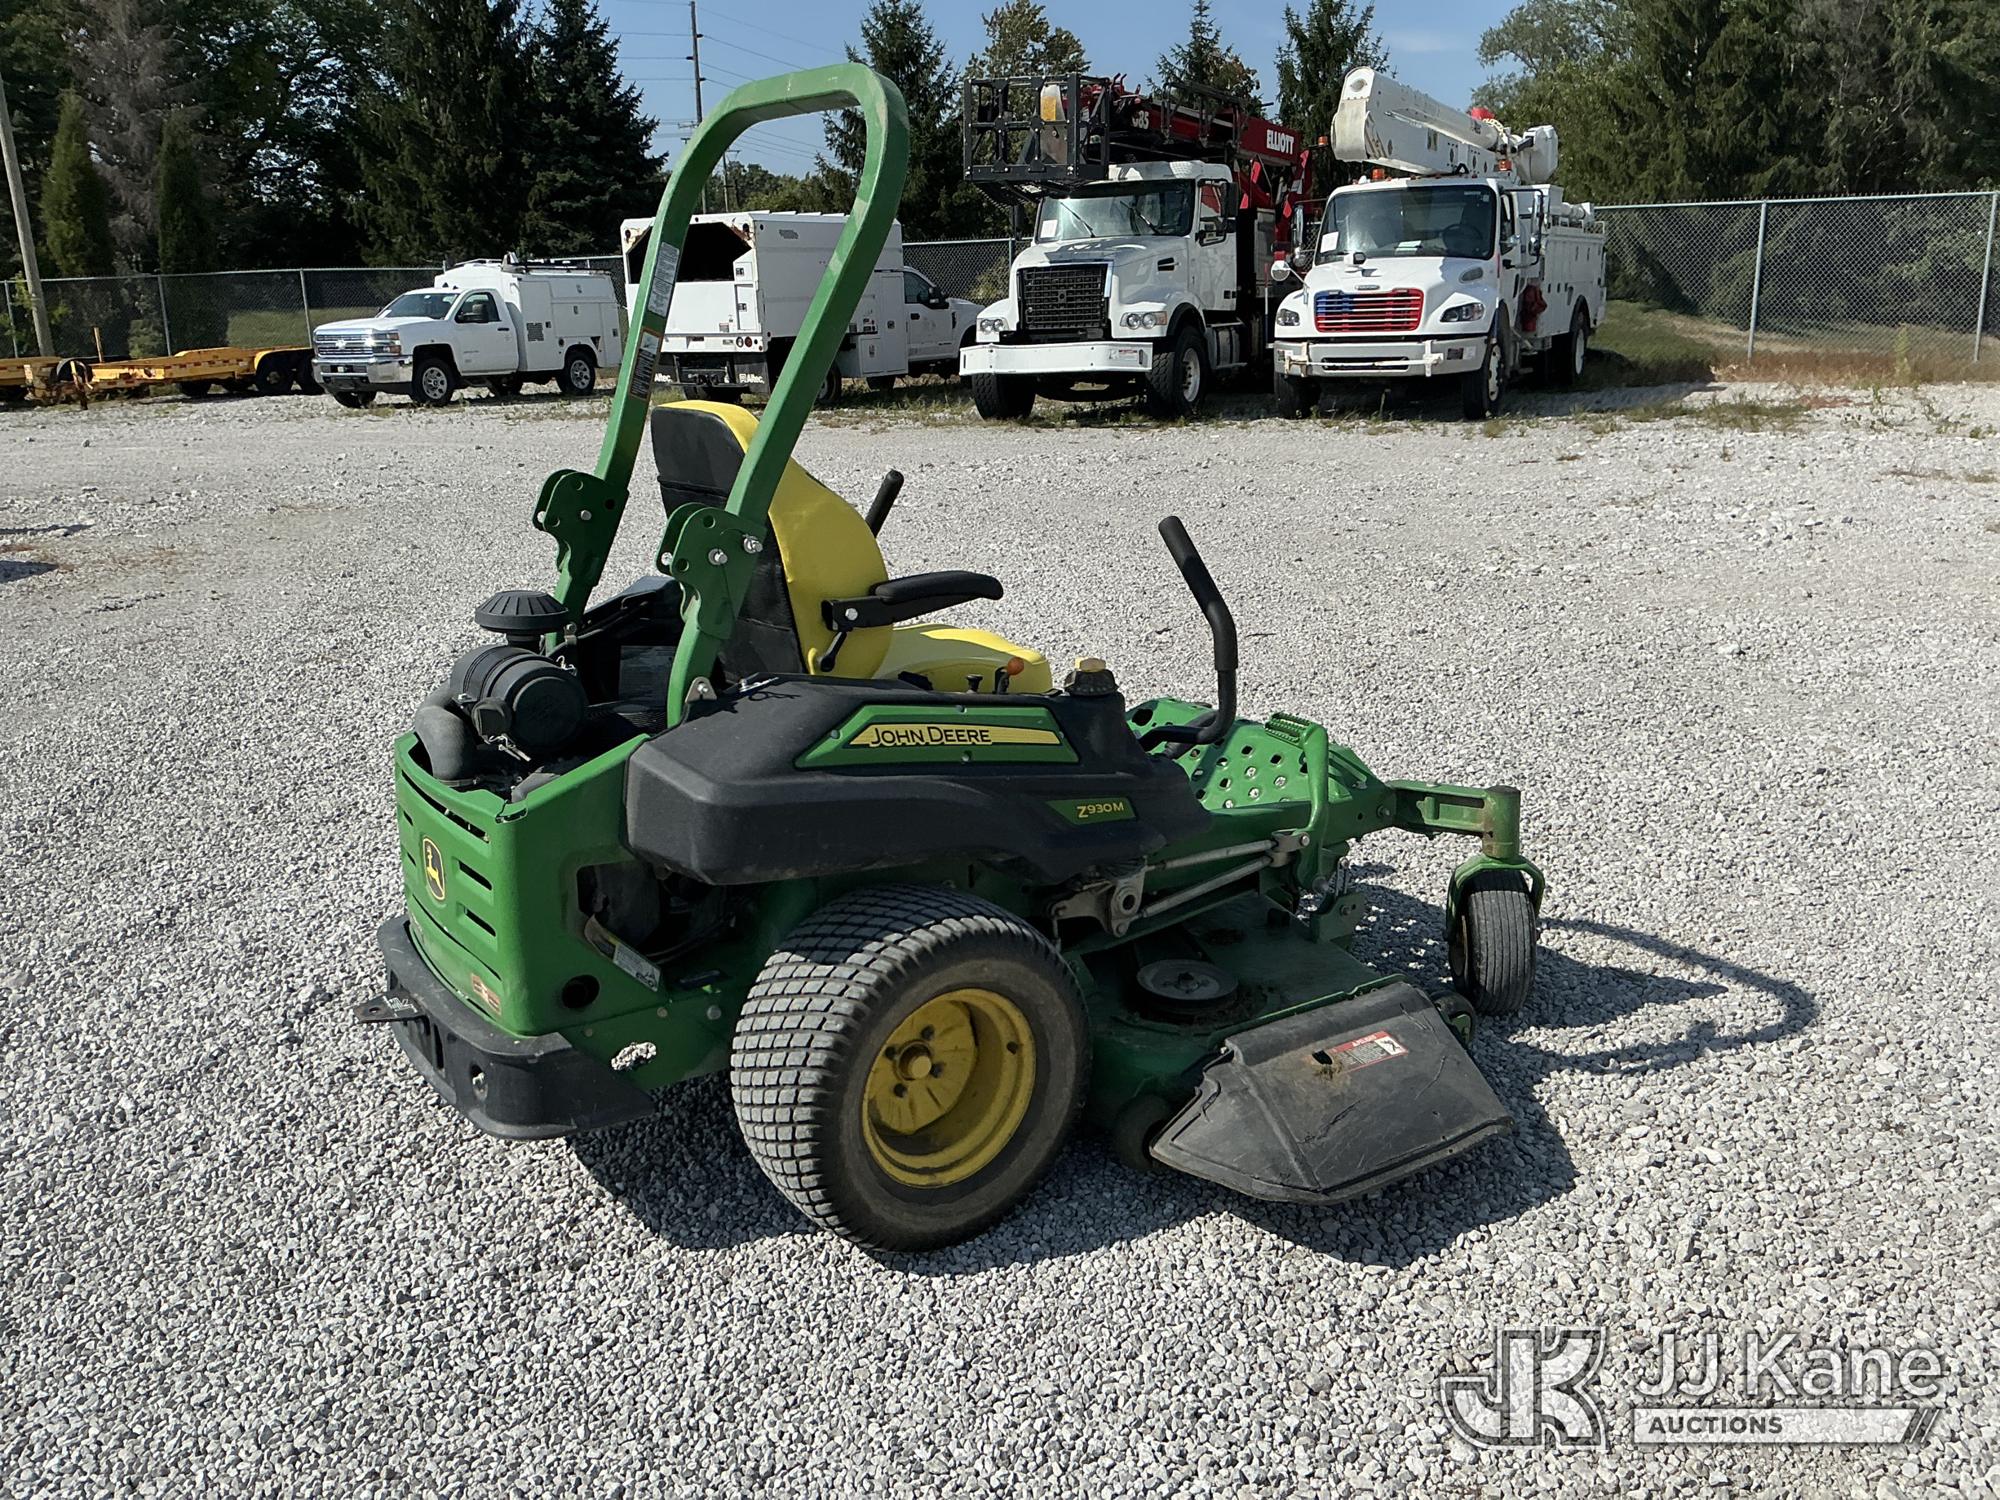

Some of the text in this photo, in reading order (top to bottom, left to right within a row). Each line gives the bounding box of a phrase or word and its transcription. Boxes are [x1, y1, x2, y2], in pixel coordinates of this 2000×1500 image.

[1266, 129, 1295, 155] ELLIOTT
[871, 727, 991, 746] JOHN DEERE
[1076, 801, 1124, 818] Z930M
